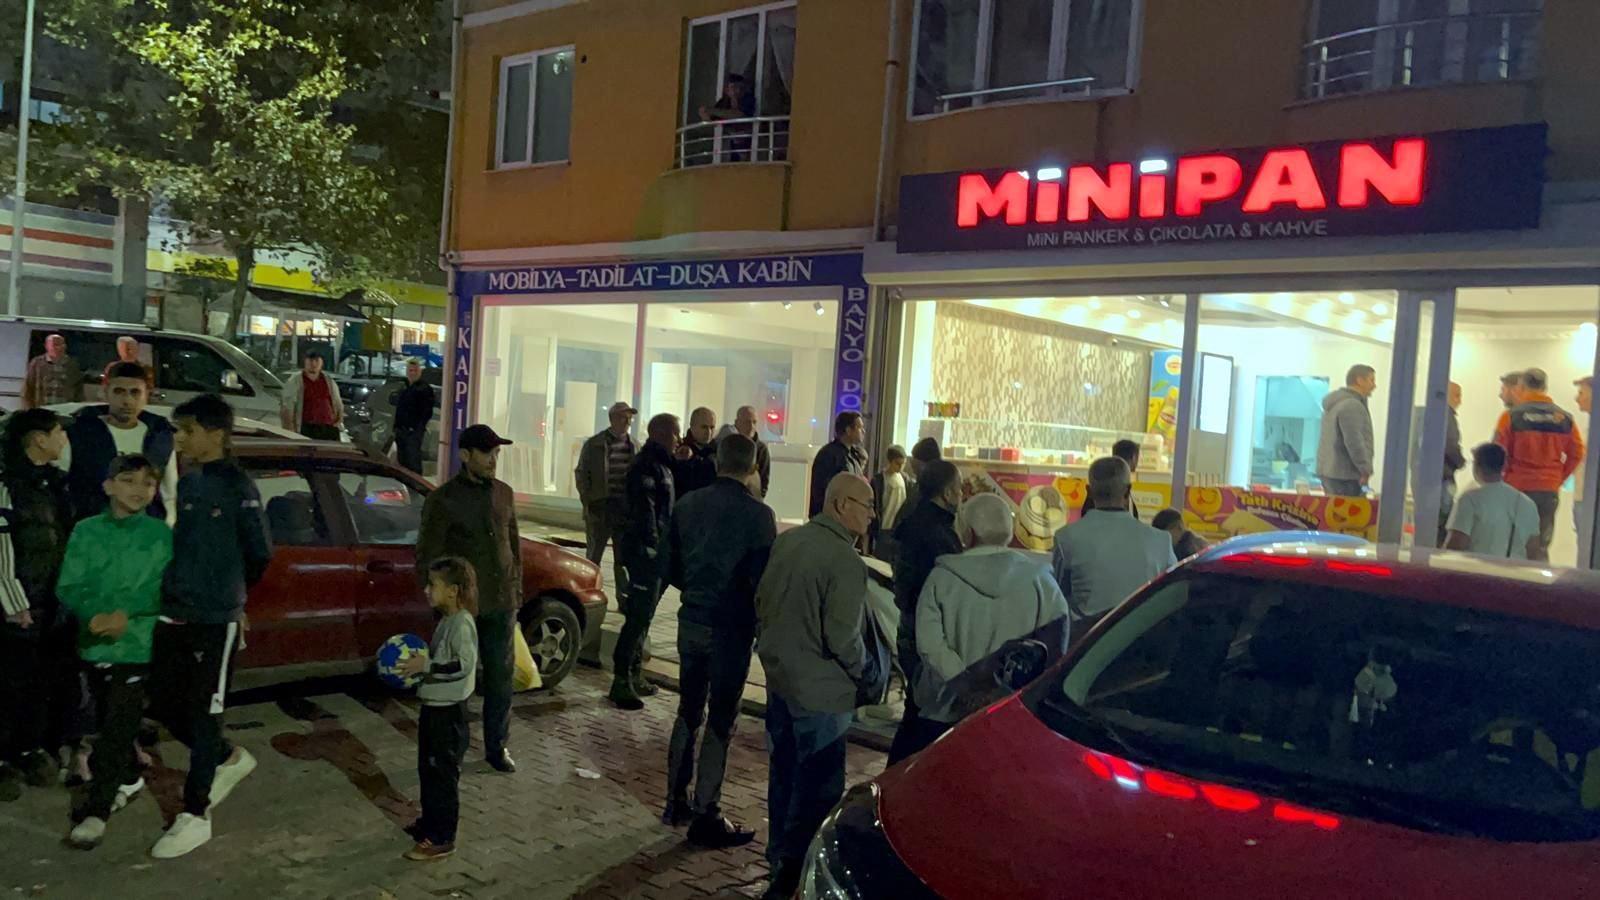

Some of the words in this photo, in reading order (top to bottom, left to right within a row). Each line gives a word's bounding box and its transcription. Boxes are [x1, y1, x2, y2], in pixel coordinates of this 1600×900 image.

[1063, 227, 1129, 245] PANKEK
[1133, 227, 1145, 242] &
[1240, 221, 1252, 238] &
[1259, 219, 1328, 236] KAHVE
[737, 256, 813, 283] KABİN
[842, 287, 866, 362] BANYO
[455, 327, 470, 430] KAPI
[838, 379, 861, 417] DO
